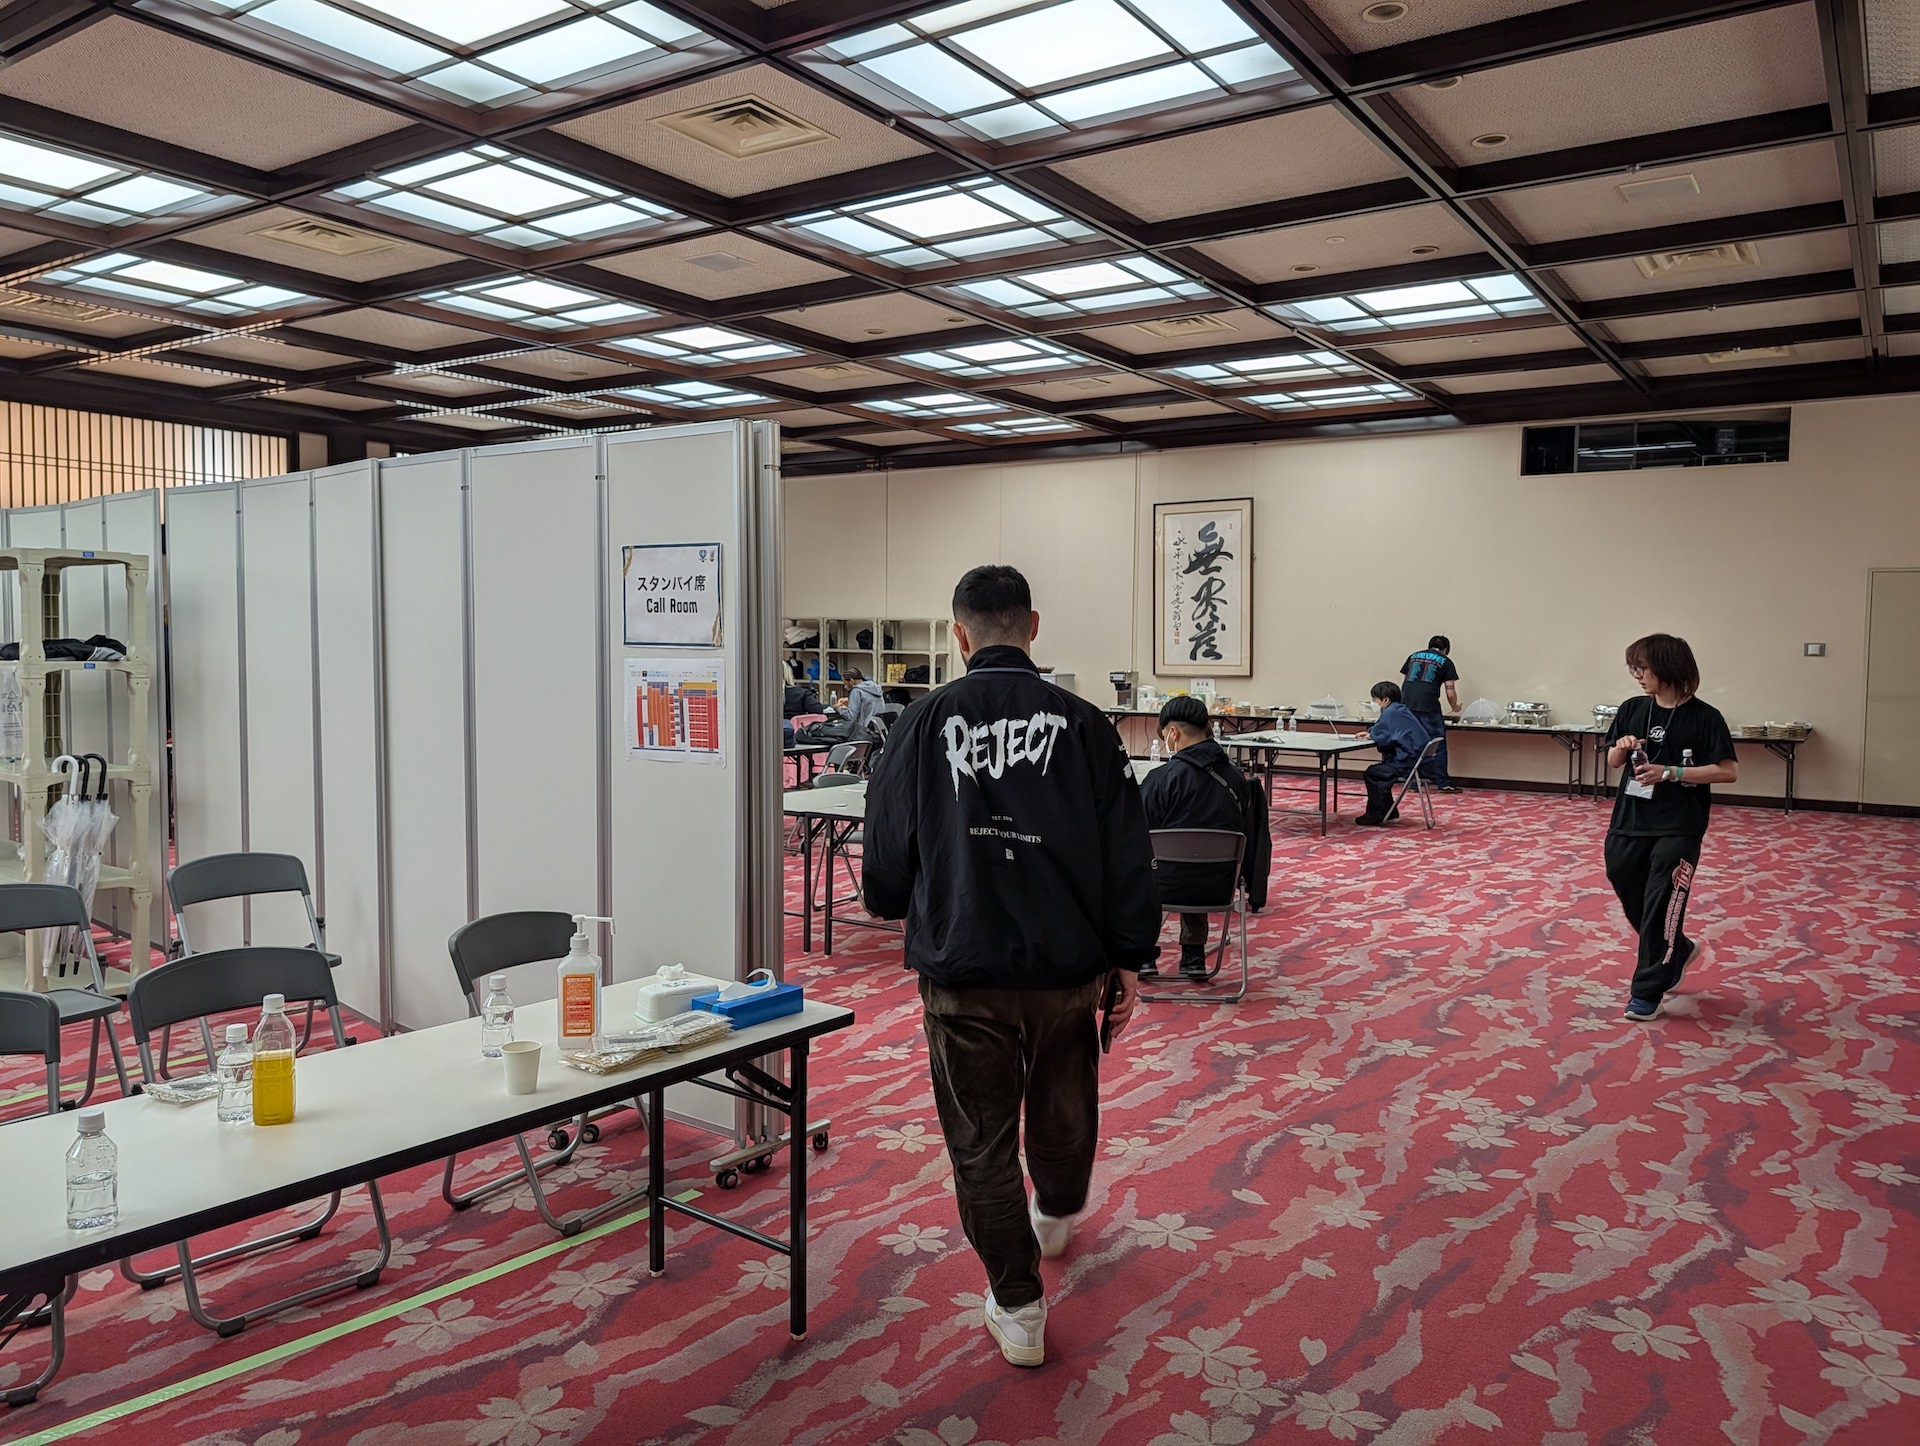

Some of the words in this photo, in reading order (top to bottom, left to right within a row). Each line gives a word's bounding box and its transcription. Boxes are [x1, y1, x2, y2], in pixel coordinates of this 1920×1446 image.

[637, 574, 706, 592] スタンバイ席
[646, 597, 666, 613] Call
[670, 598, 698, 613] Room
[939, 710, 1067, 803] REJECT
[969, 827, 998, 836] REJECT
